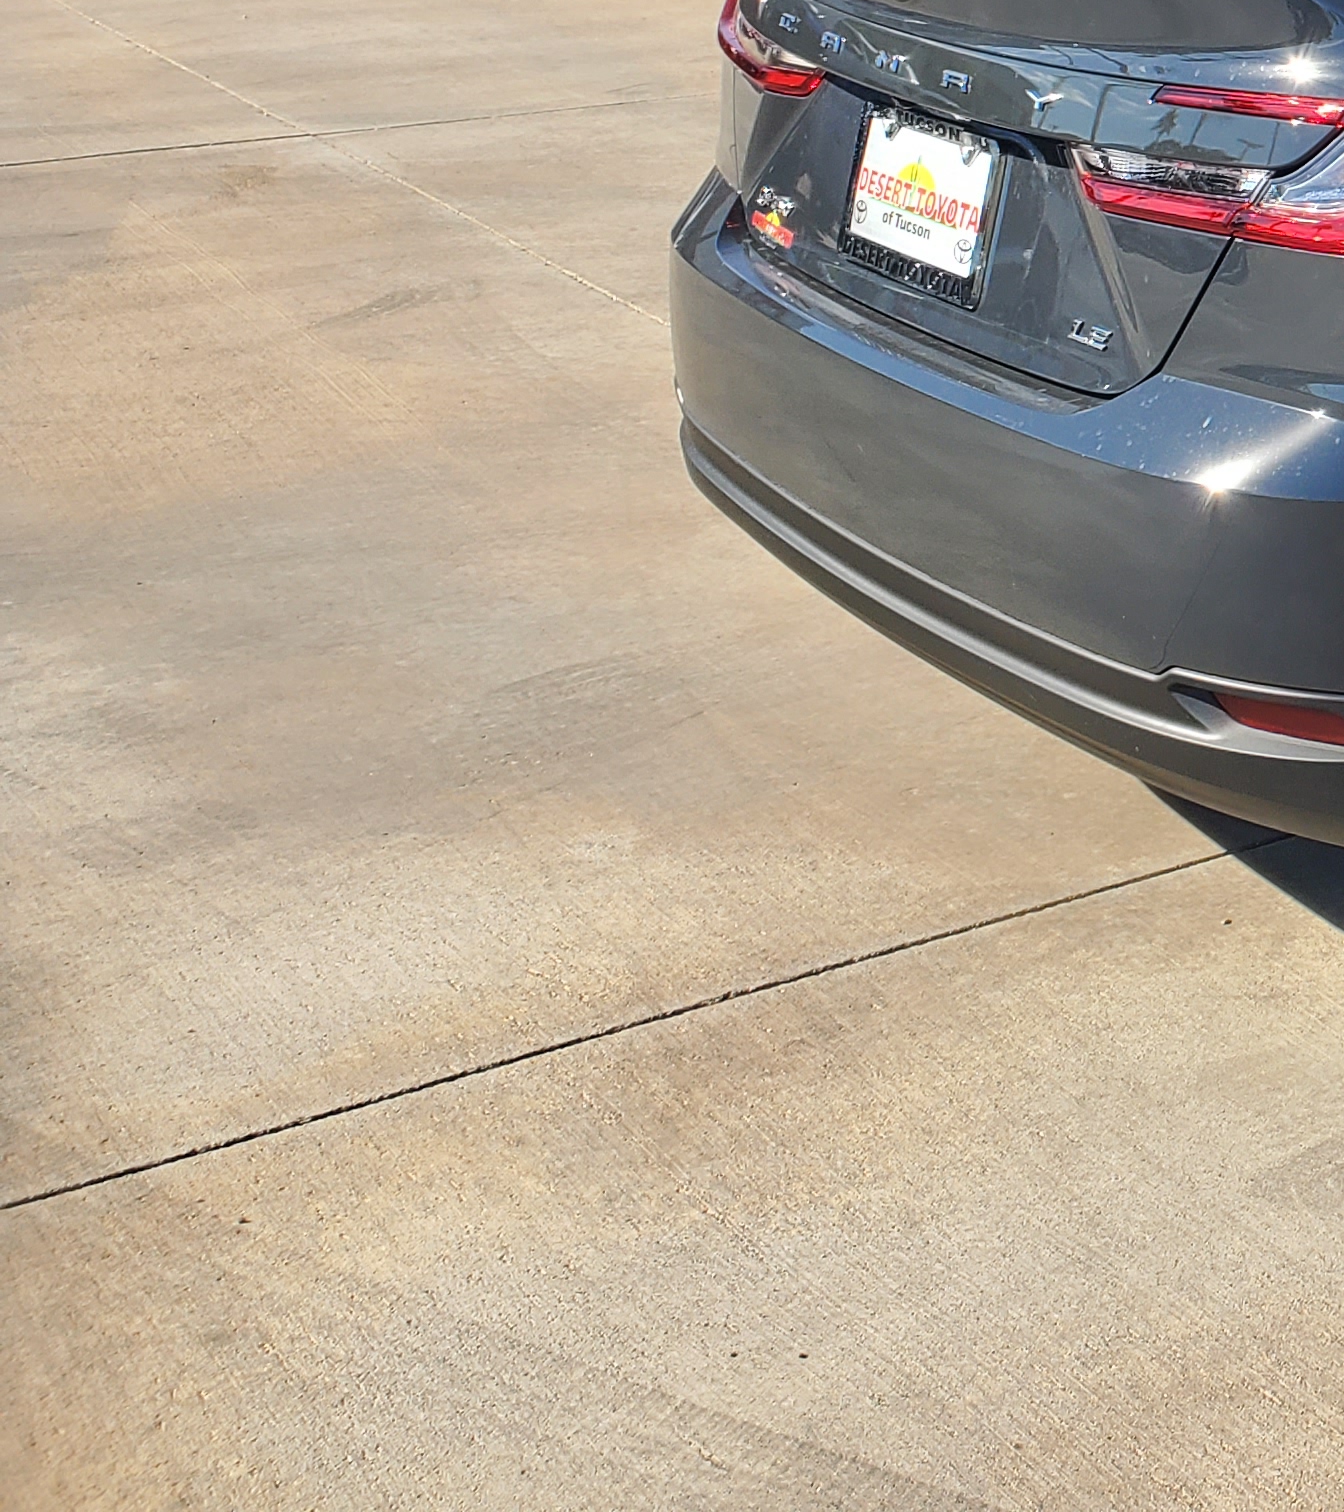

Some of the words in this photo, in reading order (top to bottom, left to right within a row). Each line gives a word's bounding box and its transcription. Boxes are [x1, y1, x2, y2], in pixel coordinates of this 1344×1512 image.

[779, 12, 1064, 111] CAMRY
[859, 167, 912, 208] DESERT
[916, 187, 980, 233] TOYOTA
[882, 210, 895, 224] of
[894, 213, 931, 239] Tucson
[1067, 319, 1113, 351] LE
